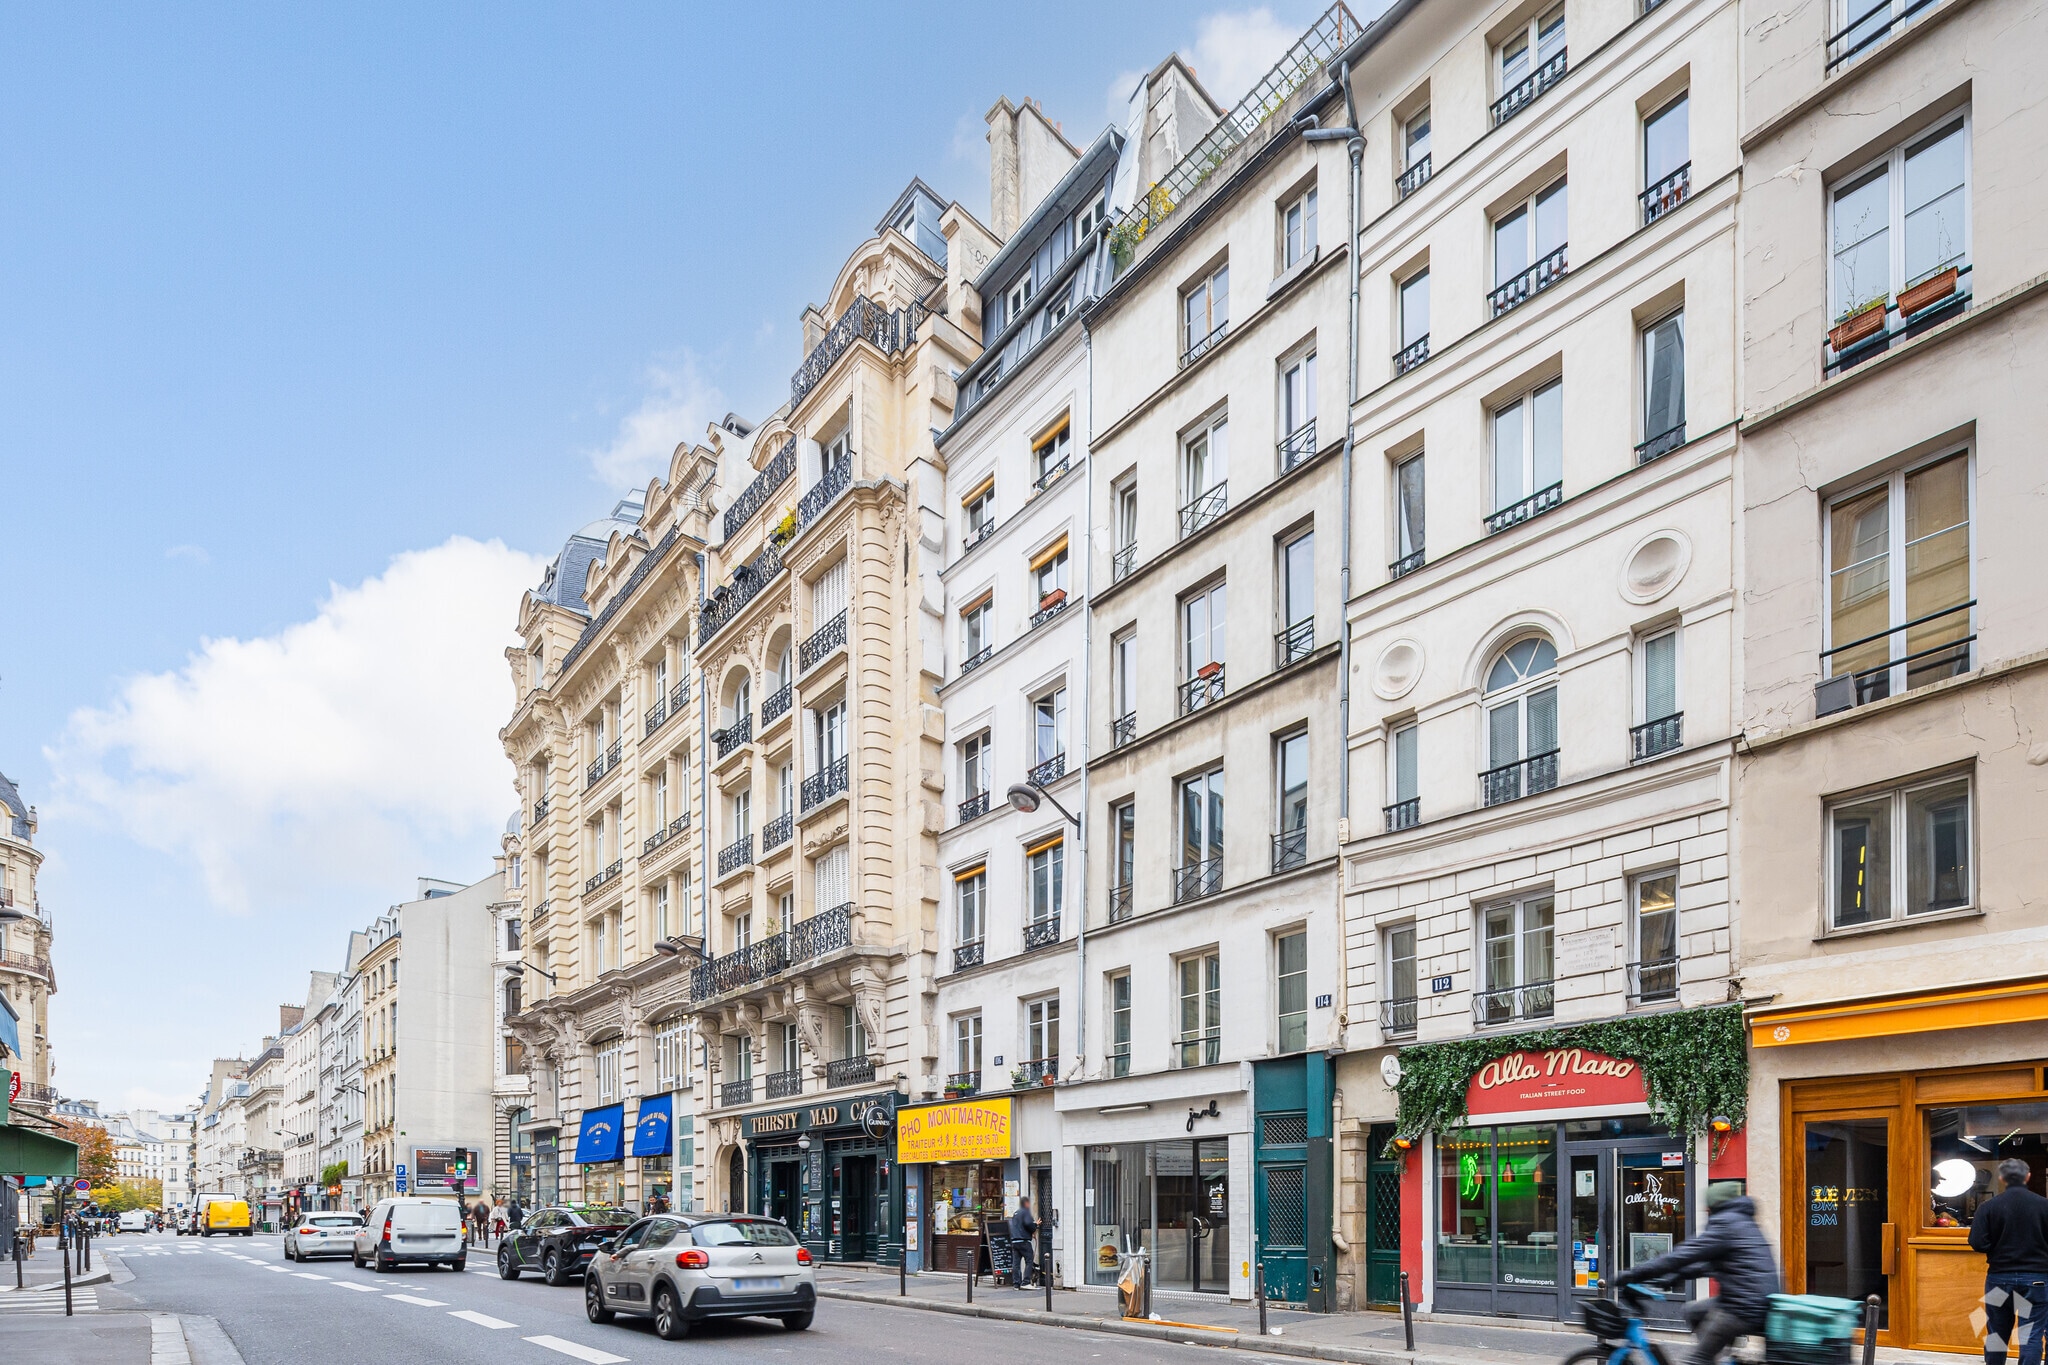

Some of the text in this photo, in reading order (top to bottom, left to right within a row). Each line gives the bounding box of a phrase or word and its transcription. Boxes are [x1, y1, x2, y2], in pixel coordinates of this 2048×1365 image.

[1434, 978, 1450, 991] 112
[1317, 995, 1330, 1007] 114
[1478, 1049, 1634, 1090] Alla Mano
[1520, 1091, 1543, 1099] ITALIAN
[751, 1112, 799, 1133] THIRSTY
[809, 1106, 838, 1127] MAD
[868, 1118, 891, 1126] GUINNESS
[1186, 1100, 1220, 1132] junk
[900, 1107, 1007, 1141] PHO MONTMARTRE
[907, 1138, 935, 1150] TRAITEUR
[992, 1134, 998, 1144] 70
[971, 1148, 977, 1156] ET
[980, 1146, 1007, 1156] CHINOISES
[1625, 1192, 1680, 1206] Alla Mano
[1514, 1277, 1555, 1286] @allamanoparis
